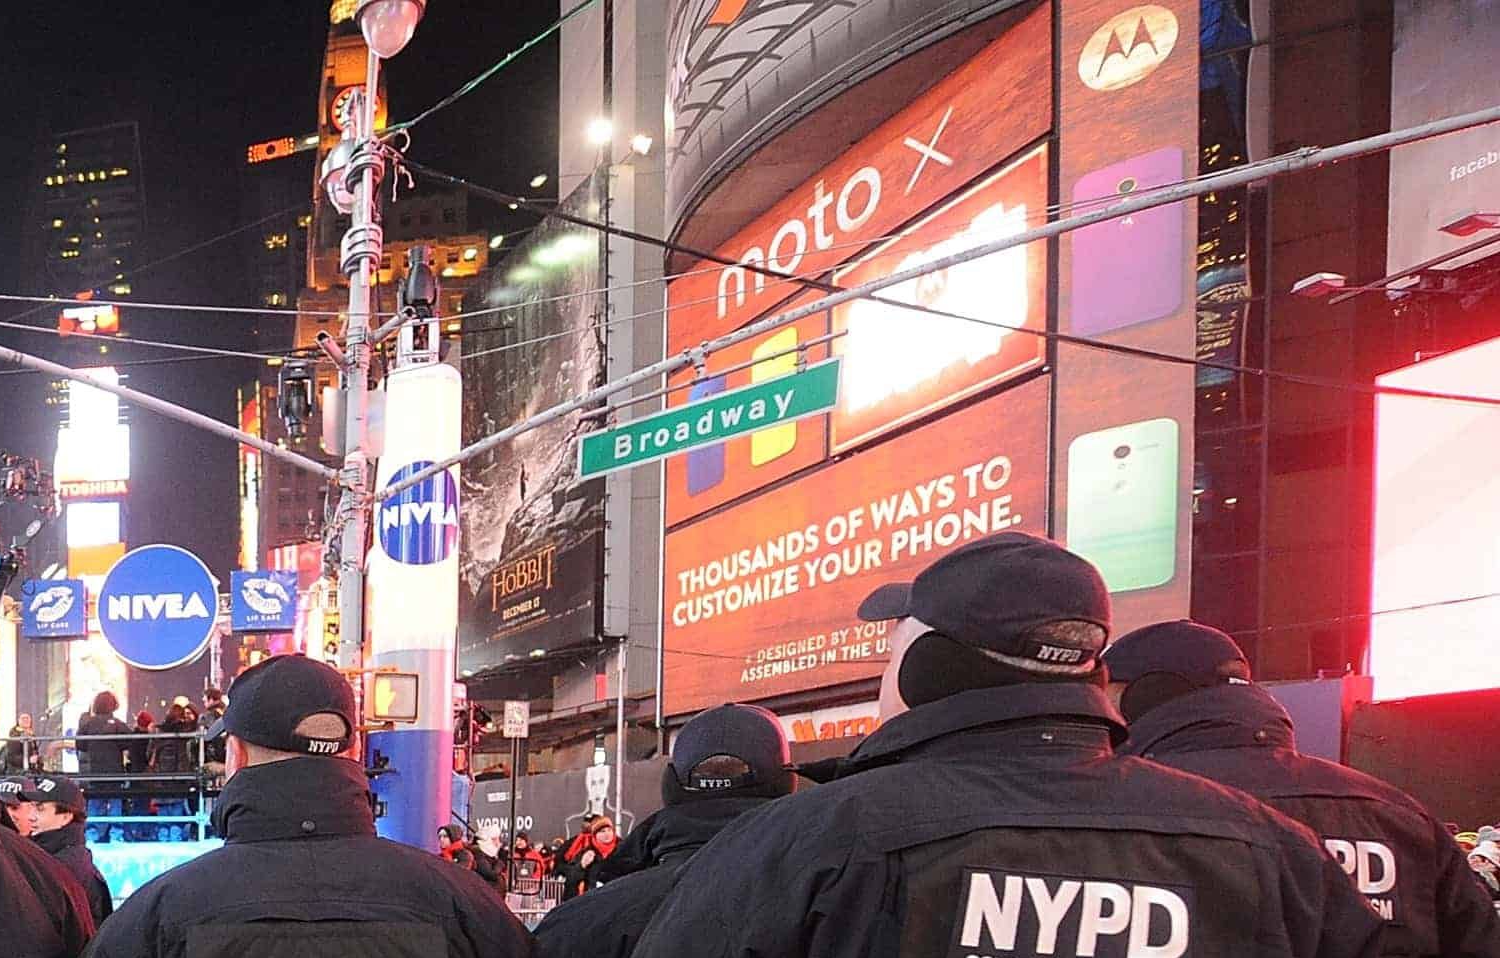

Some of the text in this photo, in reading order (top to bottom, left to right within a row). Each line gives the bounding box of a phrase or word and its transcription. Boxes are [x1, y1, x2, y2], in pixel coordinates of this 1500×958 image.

[1450, 151, 1500, 182] faceb
[717, 166, 883, 319] moto
[613, 389, 796, 459] Broadway
[382, 502, 458, 532] NIVEA
[677, 455, 1013, 597] THOUSANDS OF WAYS TO
[671, 494, 1023, 627] CUSTOMIZE YOUR PHONE.
[108, 592, 209, 621] NIVEA
[757, 620, 888, 663] DESIGNED BY YOU
[1037, 645, 1082, 662] NYPD
[740, 653, 818, 683] ASSEMBLED
[821, 650, 837, 666] IN
[842, 640, 872, 661] THE
[307, 739, 341, 754] NYPD
[700, 778, 732, 788] NYPD
[477, 815, 533, 832] VORNDO
[1325, 838, 1396, 894] PD
